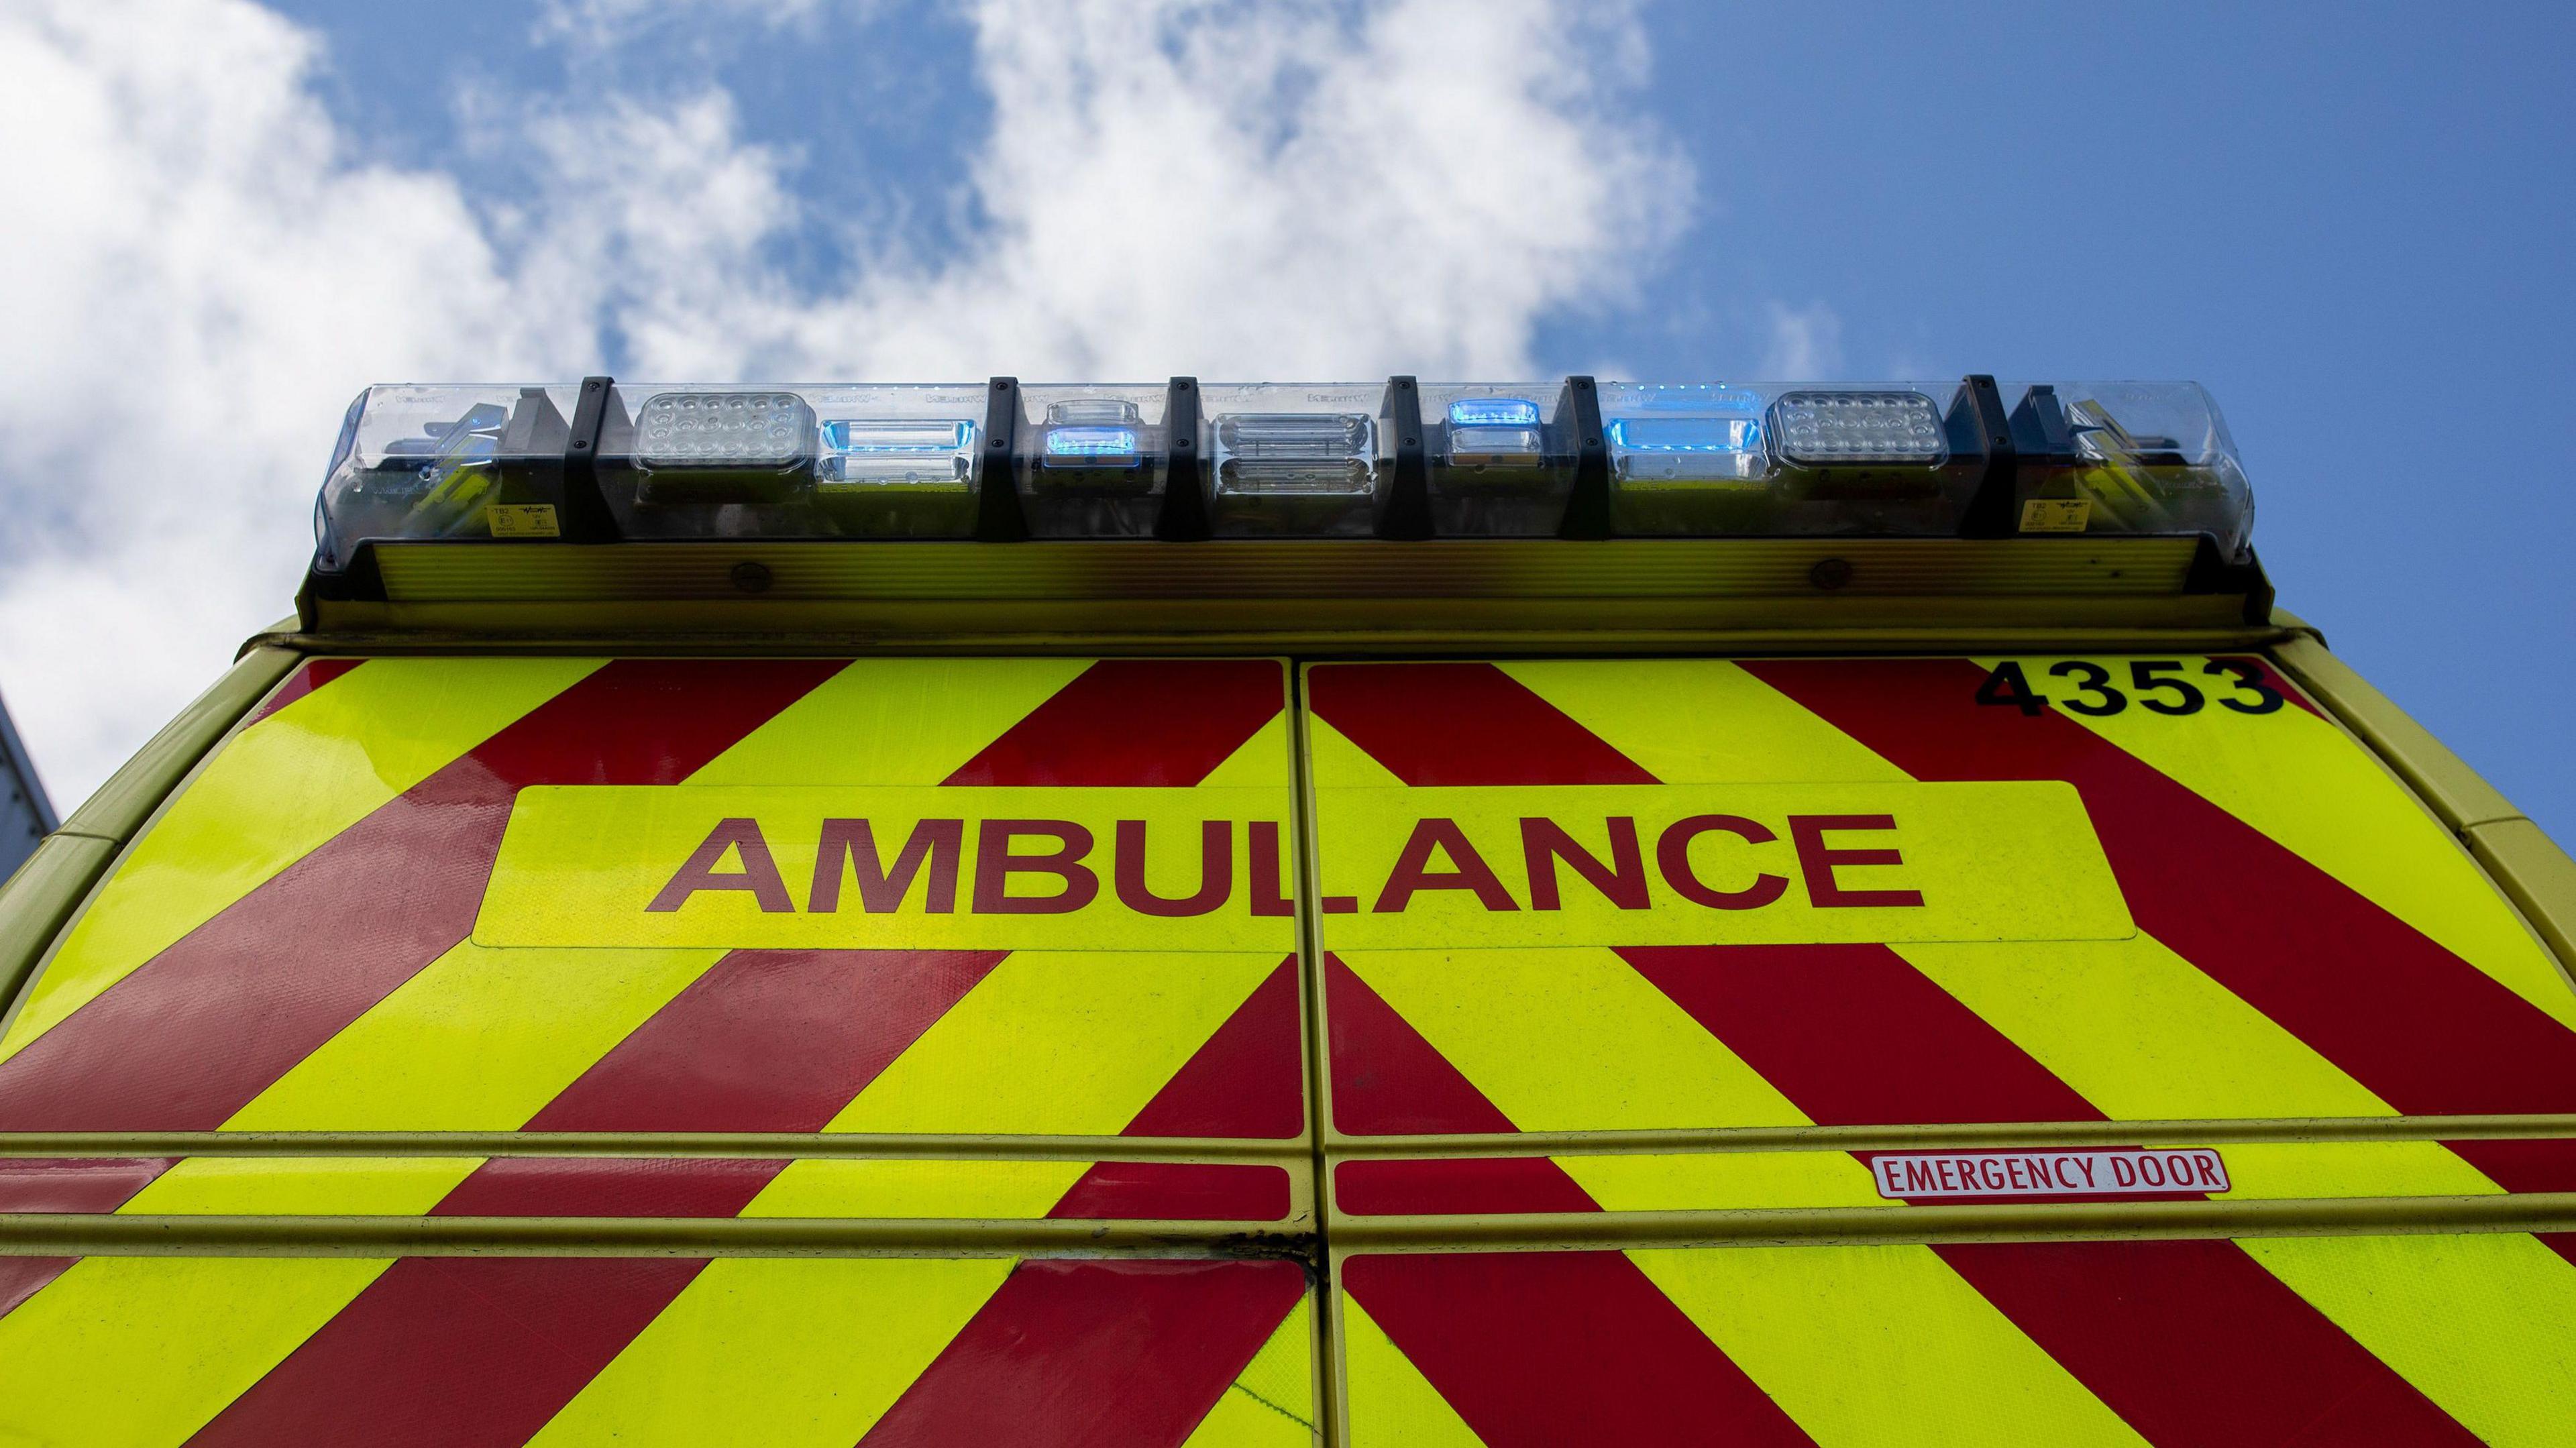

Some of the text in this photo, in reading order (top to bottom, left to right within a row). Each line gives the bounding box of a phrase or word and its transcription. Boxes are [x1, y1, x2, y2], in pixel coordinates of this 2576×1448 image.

[1975, 660, 2284, 716] 4353
[647, 815, 1924, 916] AMBULANCE
[1883, 1155, 2220, 1192] EMERGENCY DOOR
